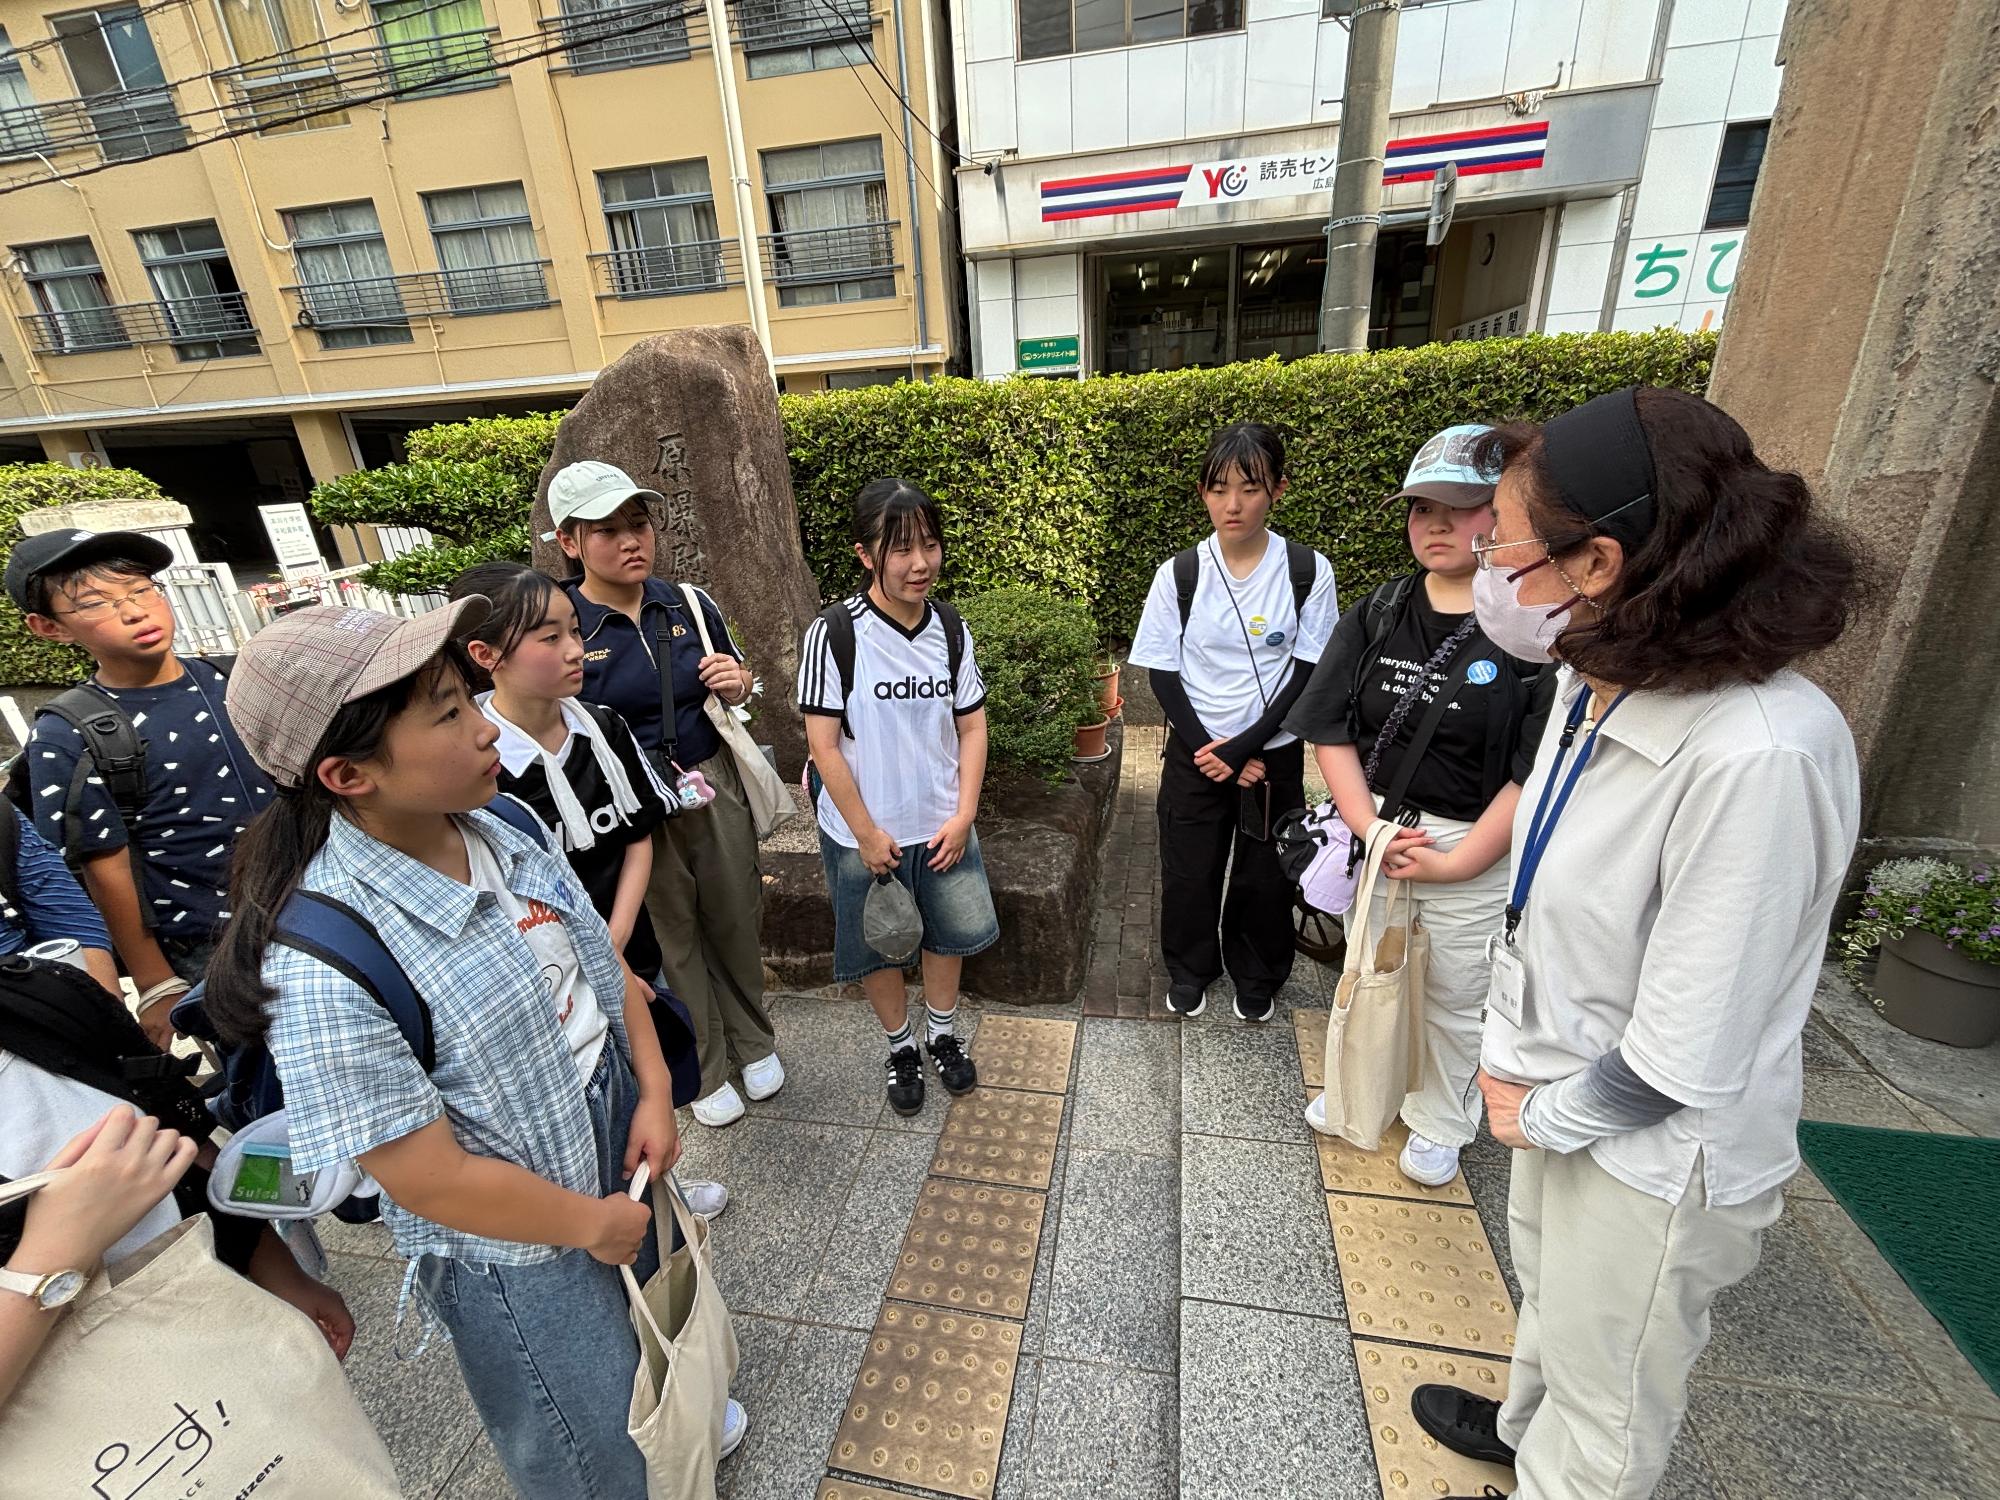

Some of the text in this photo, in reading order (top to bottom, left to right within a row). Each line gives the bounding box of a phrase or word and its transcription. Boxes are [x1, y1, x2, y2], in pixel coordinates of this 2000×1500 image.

[1260, 156, 1335, 181] 読売セン
[671, 623, 687, 637] 85
[1378, 655, 1424, 673] verythin
[1394, 671, 1406, 681] in
[873, 676, 952, 700] adida
[1381, 681, 1391, 692] is
[1421, 690, 1434, 704] by
